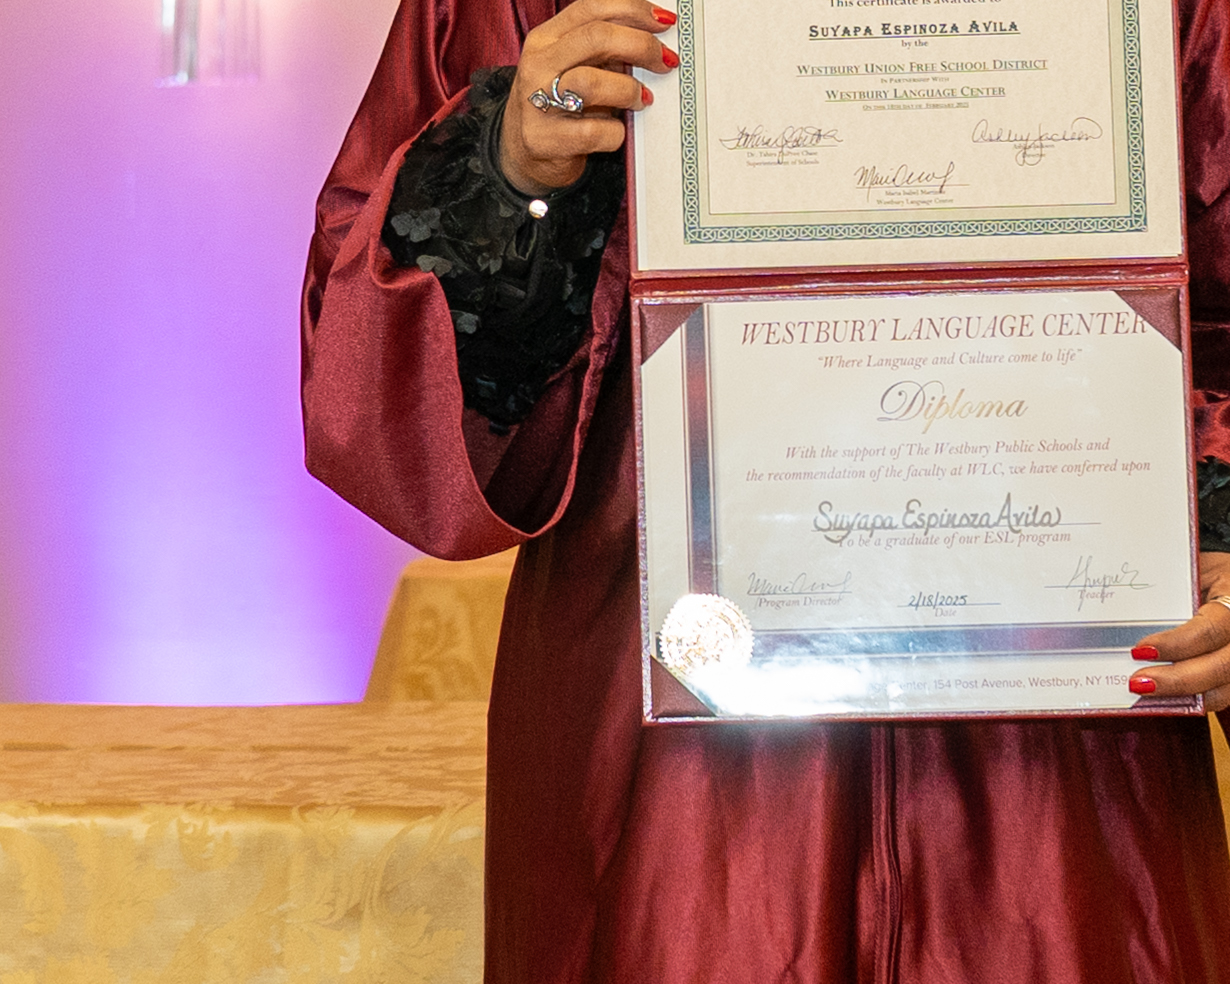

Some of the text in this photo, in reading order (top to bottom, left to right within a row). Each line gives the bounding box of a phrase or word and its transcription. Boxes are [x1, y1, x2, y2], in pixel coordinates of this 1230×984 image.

[809, 20, 1019, 38] SUYAPA ESPINOZA AVILA
[901, 38, 929, 49] by the
[741, 311, 1148, 345] WESTBURY LANGUAGE CENTER
[866, 354, 928, 370] Language
[931, 352, 955, 365] and
[959, 351, 1004, 365] Culture
[1008, 354, 1038, 363] come
[1041, 351, 1053, 362] to
[876, 380, 1028, 435] Diploma
[785, 438, 1111, 462] With the support of The Westbury Public Schools and
[746, 459, 1151, 482] the recommendation of the faculty at WLC, we have conferred upon
[813, 492, 1061, 543] Suyapa Espinoza Avila
[858, 534, 871, 547] be
[874, 538, 882, 547] a
[885, 533, 940, 550] graduate
[943, 533, 958, 549] of
[959, 534, 980, 544] our
[984, 531, 1014, 544] ESL
[1018, 532, 1071, 547] program
[758, 596, 842, 610] Program Director
[908, 591, 968, 611] 2/18/2025
[934, 608, 957, 618] Date
[933, 678, 951, 690] 154
[955, 678, 979, 689] Post
[981, 677, 1026, 690] Avenue,
[1028, 676, 1083, 689] Westbury,
[1085, 675, 1102, 686] NY
[1105, 674, 1128, 685] 1159
